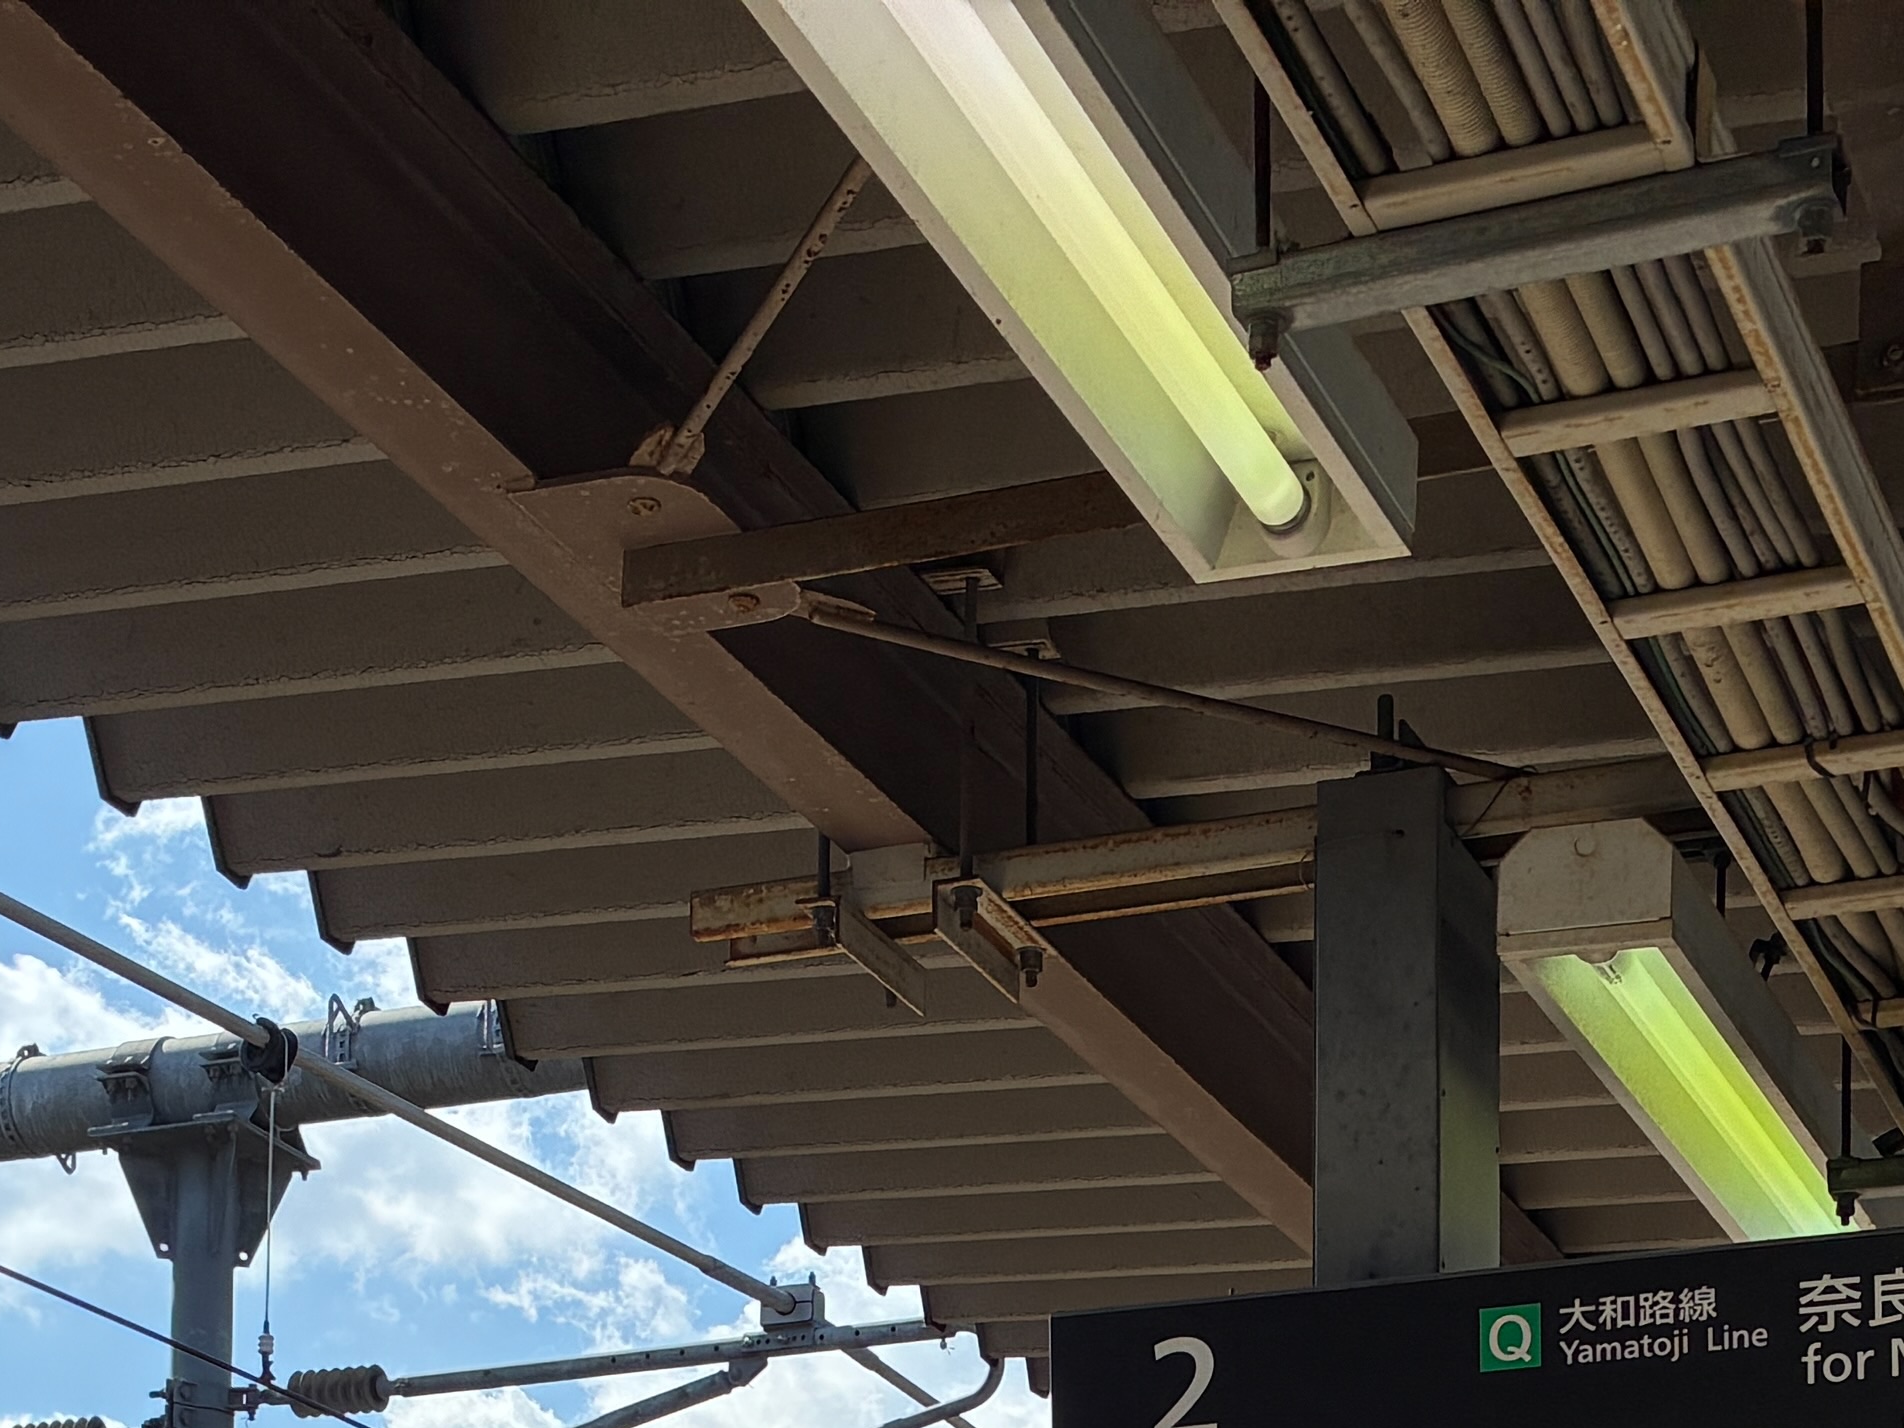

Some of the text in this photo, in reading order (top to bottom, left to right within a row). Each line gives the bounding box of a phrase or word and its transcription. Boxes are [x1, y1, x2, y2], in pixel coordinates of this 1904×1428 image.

[1559, 1286, 1717, 1334] 大和路線
[1488, 1314, 1532, 1363] Q
[1559, 1325, 1768, 1365] Yamatoji Line
[1801, 1341, 1874, 1385] for
